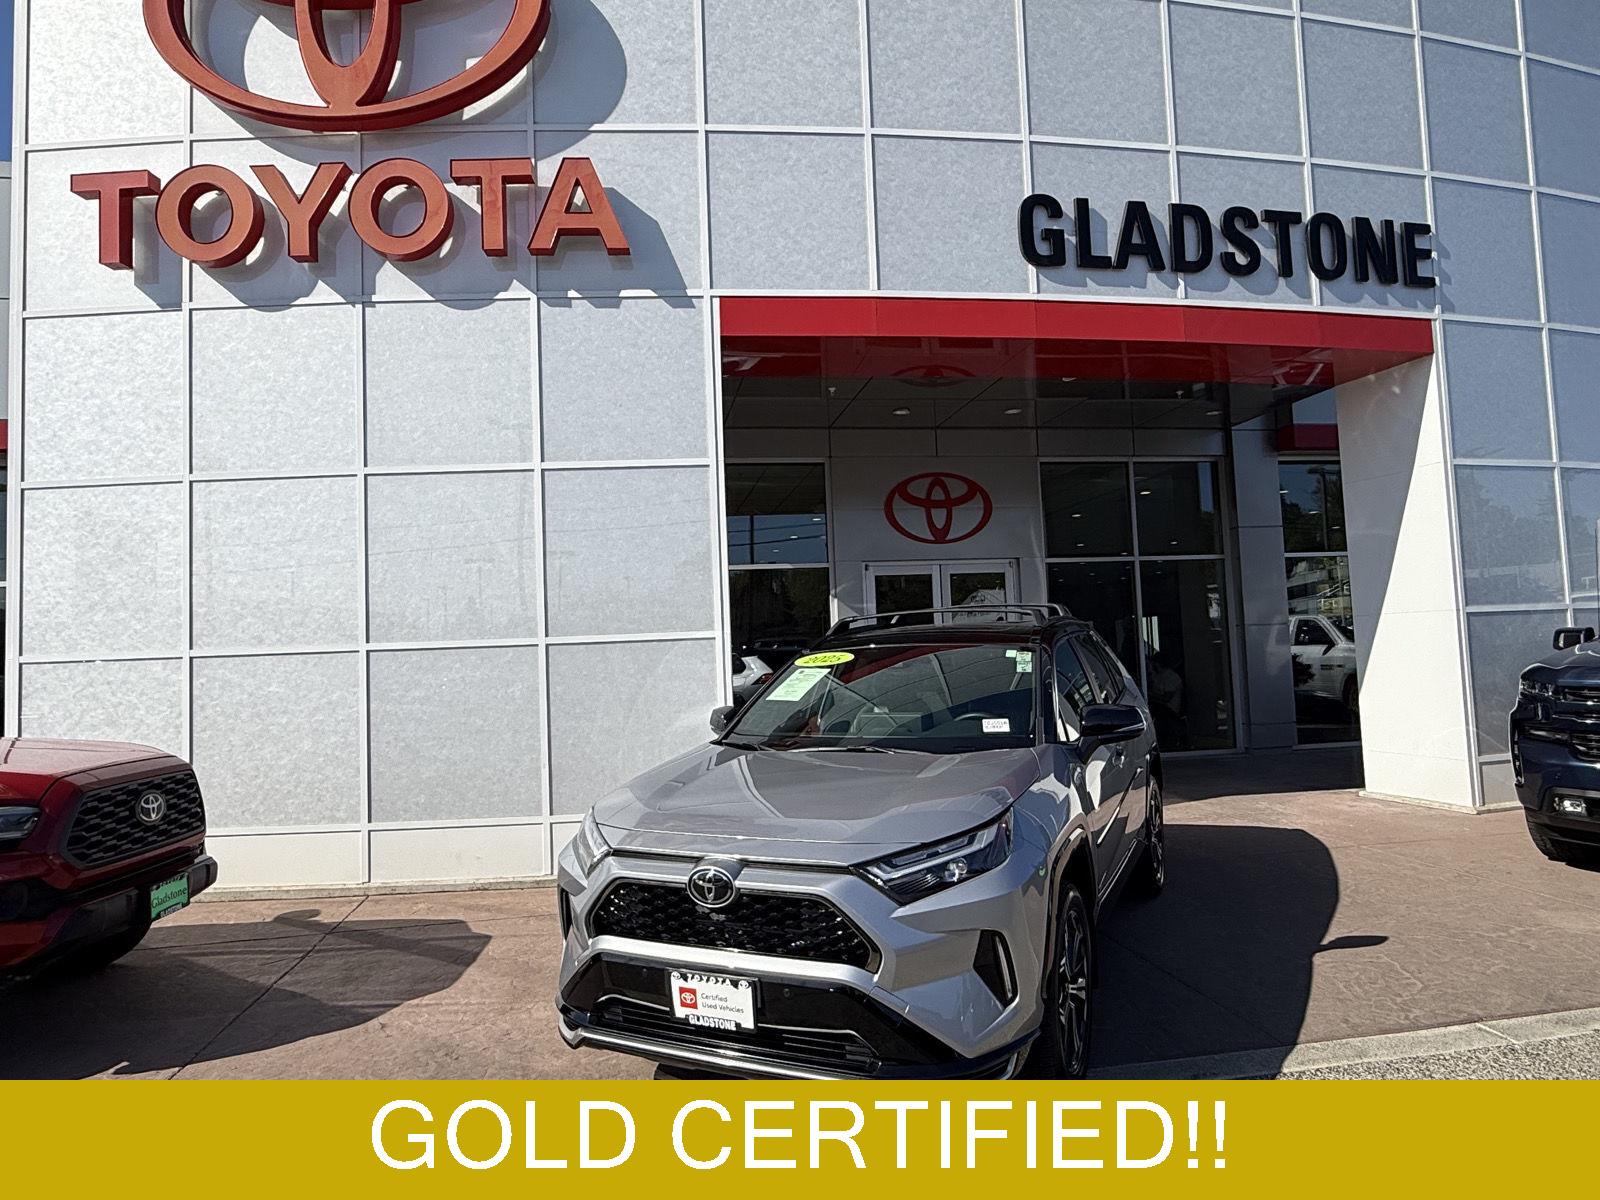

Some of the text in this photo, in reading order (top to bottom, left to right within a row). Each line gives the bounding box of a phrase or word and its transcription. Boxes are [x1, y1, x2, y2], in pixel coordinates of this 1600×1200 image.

[70, 157, 631, 270] TOYOTA
[1018, 193, 1437, 289] GLADSTONE
[151, 886, 188, 909] Gladstone
[686, 973, 732, 987] TOYOTA
[701, 992, 728, 1003] Certified
[701, 1002, 745, 1014] Used Vehicles
[688, 1014, 737, 1031] GLADSTONE
